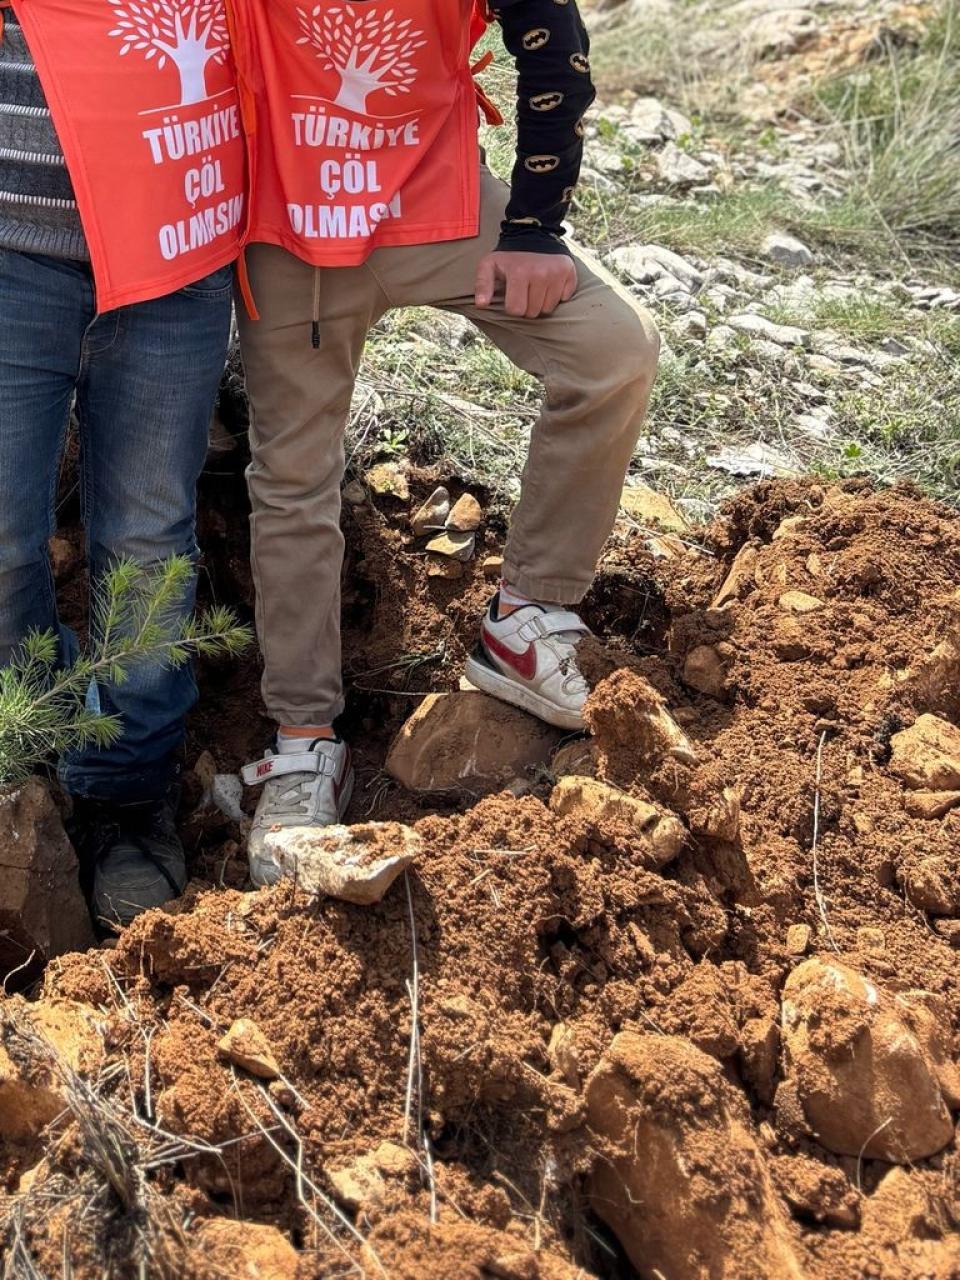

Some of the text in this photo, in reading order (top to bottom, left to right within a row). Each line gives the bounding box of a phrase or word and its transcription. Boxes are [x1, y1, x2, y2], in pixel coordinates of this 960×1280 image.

[142, 103, 240, 165] TÜRKİYE
[291, 105, 420, 151] TÜRKİYE
[184, 154, 225, 209] ÇÖL
[320, 152, 382, 201] ÇÖL
[159, 192, 244, 261] OLMASIN
[256, 760, 274, 777] NIKE
